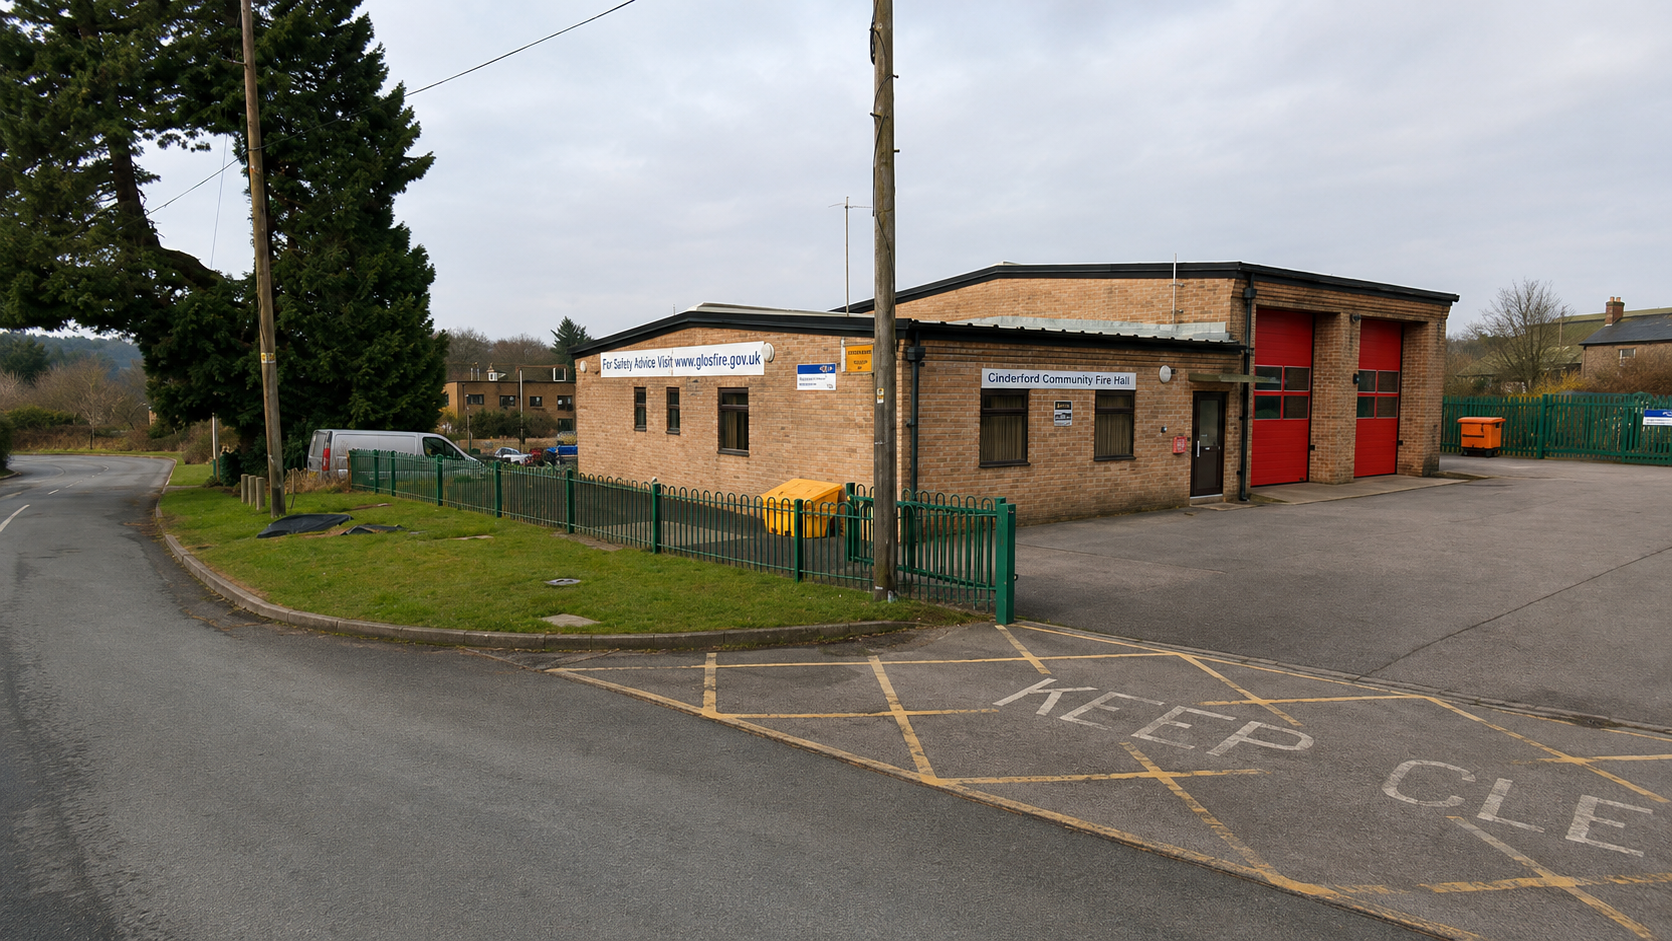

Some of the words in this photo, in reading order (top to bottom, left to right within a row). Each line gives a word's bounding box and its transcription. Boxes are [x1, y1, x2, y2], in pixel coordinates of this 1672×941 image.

[602, 358, 613, 370] For
[613, 357, 633, 372] Safety
[633, 356, 656, 369] Advice
[657, 355, 674, 369] Visit
[674, 351, 761, 371] www.glosfire.gov.uk
[988, 372, 1040, 384] Cinderford
[1042, 374, 1093, 386] Community
[1095, 375, 1112, 386] Fire
[1113, 376, 1130, 386] Hall
[992, 678, 1315, 756] KEEP
[1381, 759, 1653, 858] CLE
